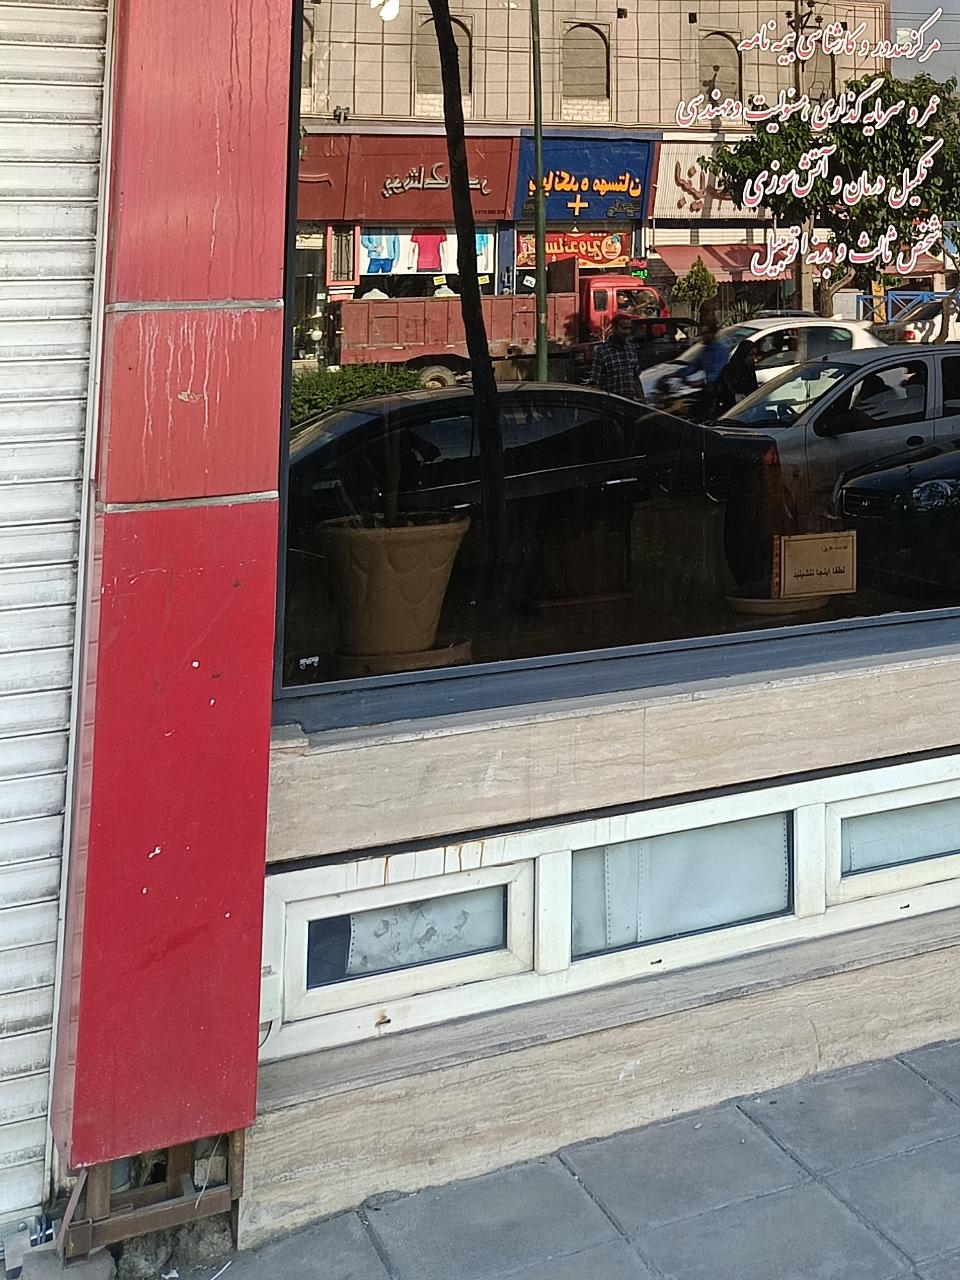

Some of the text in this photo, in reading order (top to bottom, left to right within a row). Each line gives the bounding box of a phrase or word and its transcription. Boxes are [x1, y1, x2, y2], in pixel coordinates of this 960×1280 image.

[737, 20, 777, 53] نامه
[771, 30, 797, 65] بیمه
[796, 22, 866, 60] کارشناسی
[905, 7, 942, 62] مرکز
[862, 96, 906, 136] سرمایه
[831, 176, 843, 195] و
[888, 138, 944, 209] تکمیل
[751, 225, 808, 277] اتومبیل
[835, 242, 847, 263] و
[848, 224, 898, 264] ثالث
[896, 213, 942, 274] شخص
